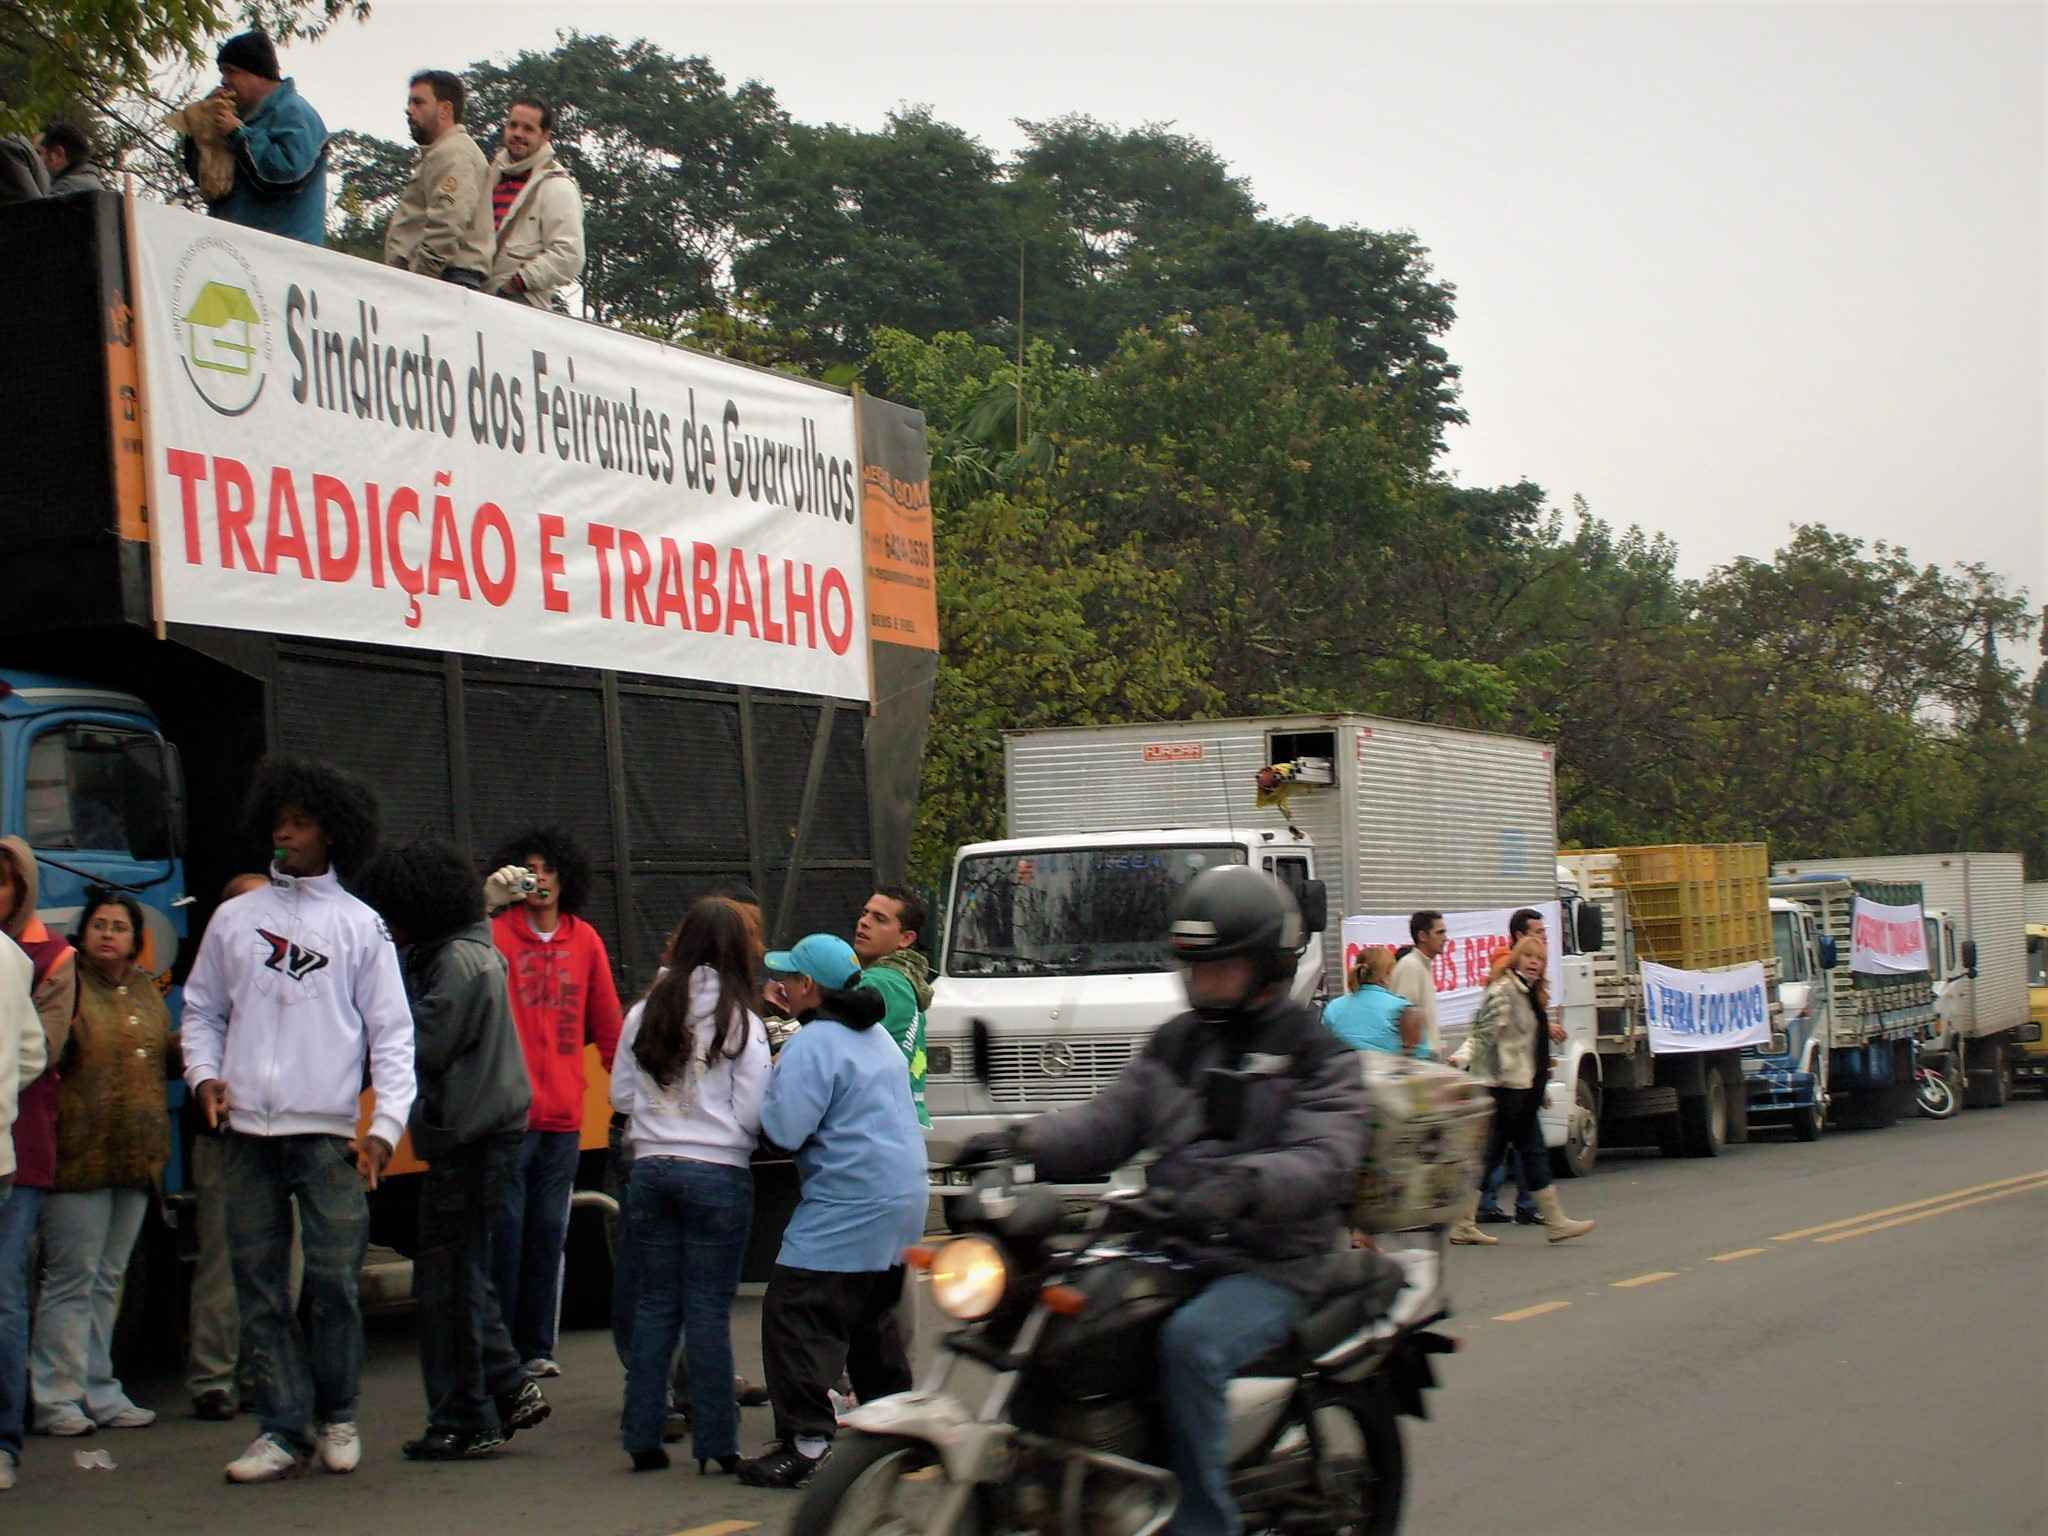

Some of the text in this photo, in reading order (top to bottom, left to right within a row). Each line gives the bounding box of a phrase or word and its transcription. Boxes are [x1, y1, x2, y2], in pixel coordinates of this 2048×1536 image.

[286, 283, 456, 438] Sindicato
[468, 331, 526, 454] dos
[532, 349, 675, 484] Feirantes
[682, 387, 716, 494] de
[723, 399, 856, 525] Guarulhos
[166, 447, 854, 656] TRADIÇÃO E TRABALHO
